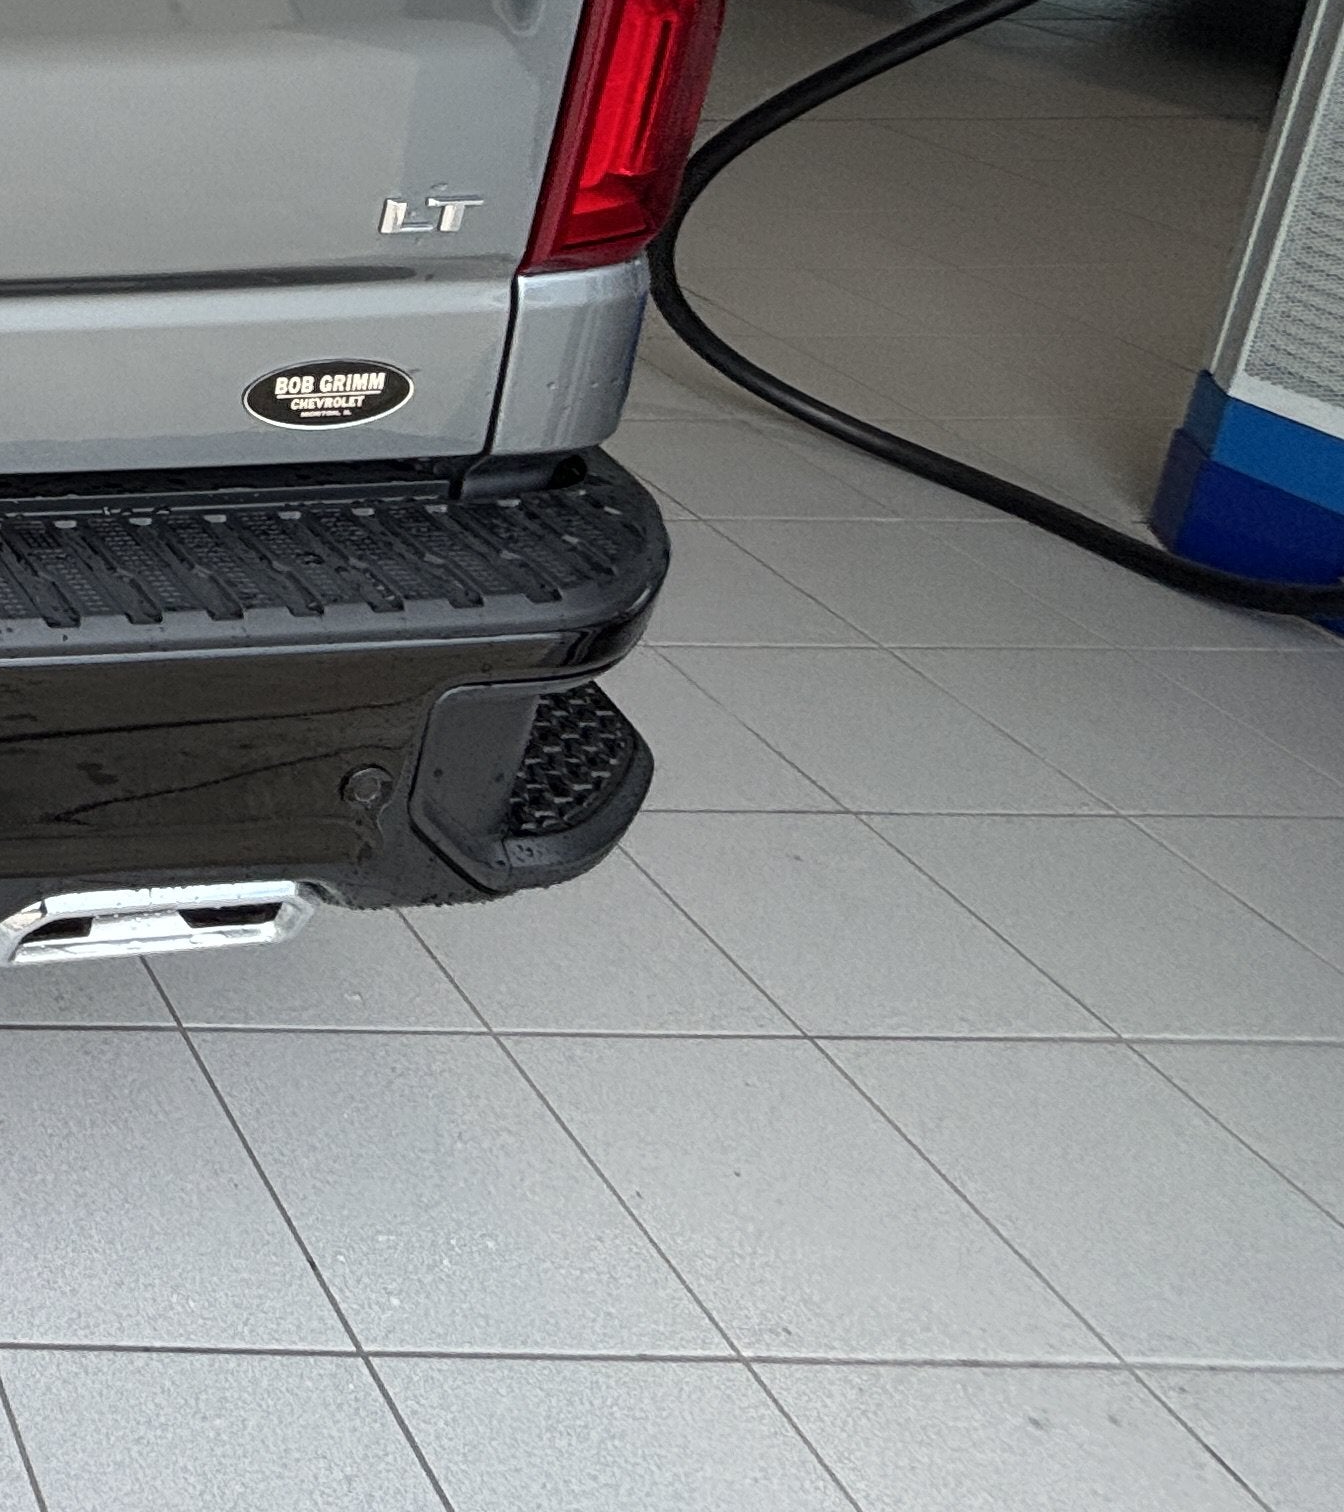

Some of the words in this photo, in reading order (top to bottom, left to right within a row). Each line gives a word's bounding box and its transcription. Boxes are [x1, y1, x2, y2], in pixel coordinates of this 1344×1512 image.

[379, 197, 484, 233] LT
[274, 375, 315, 395] BOB
[319, 372, 386, 392] GRIMM
[290, 395, 366, 410] CHEVROLET
